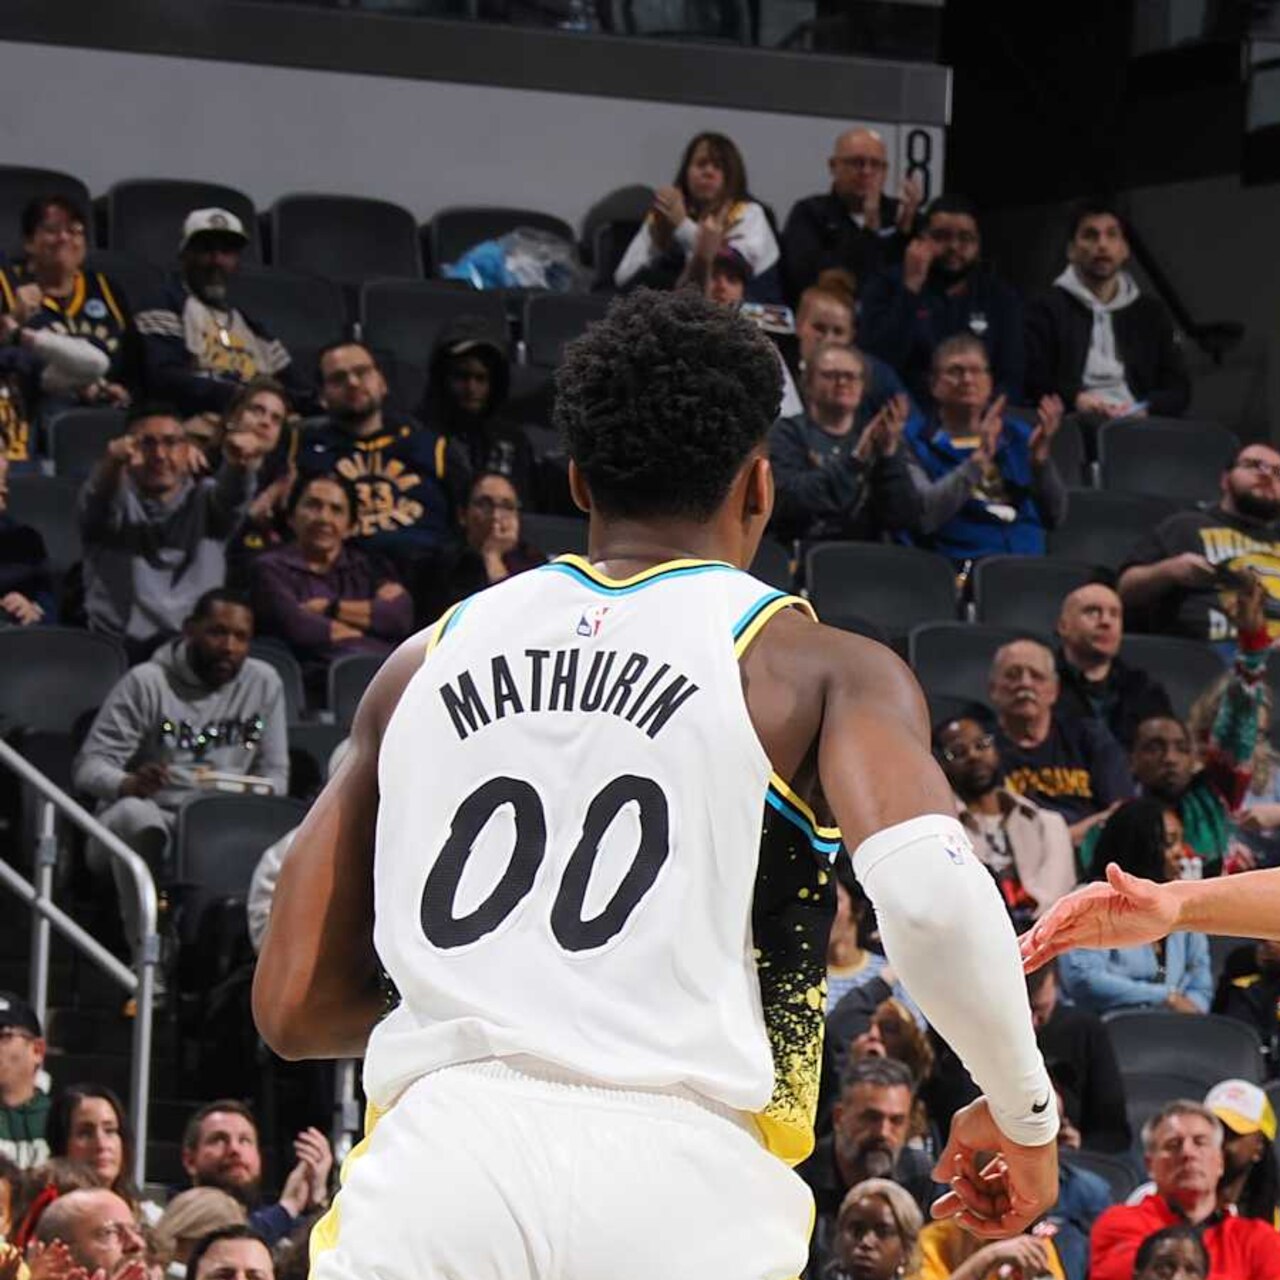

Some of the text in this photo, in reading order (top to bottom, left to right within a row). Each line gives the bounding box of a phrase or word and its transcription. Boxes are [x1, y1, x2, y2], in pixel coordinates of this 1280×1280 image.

[907, 129, 930, 206] 8
[439, 648, 699, 741] MATHURIN
[420, 774, 670, 951] 00
